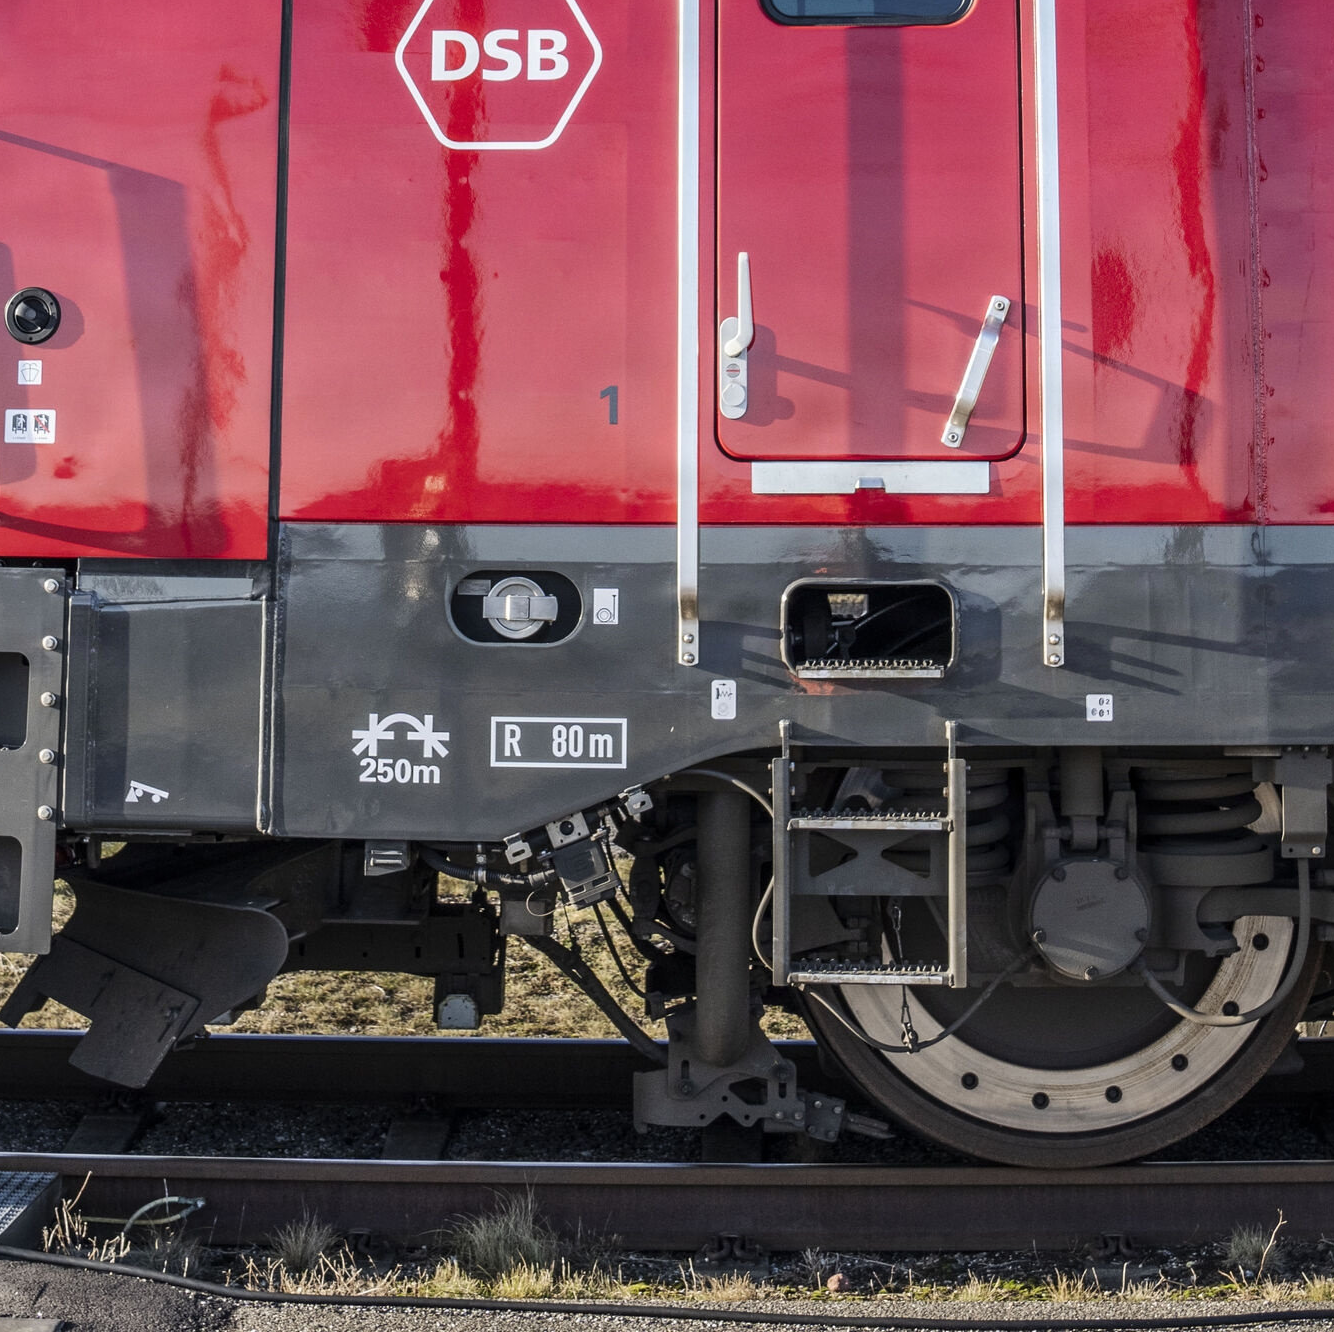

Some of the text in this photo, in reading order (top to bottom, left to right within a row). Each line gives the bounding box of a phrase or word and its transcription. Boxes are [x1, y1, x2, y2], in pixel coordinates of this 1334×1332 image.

[430, 29, 569, 81] DSB
[599, 385, 619, 425] 1
[503, 724, 522, 757] R
[359, 758, 440, 784] 250m
